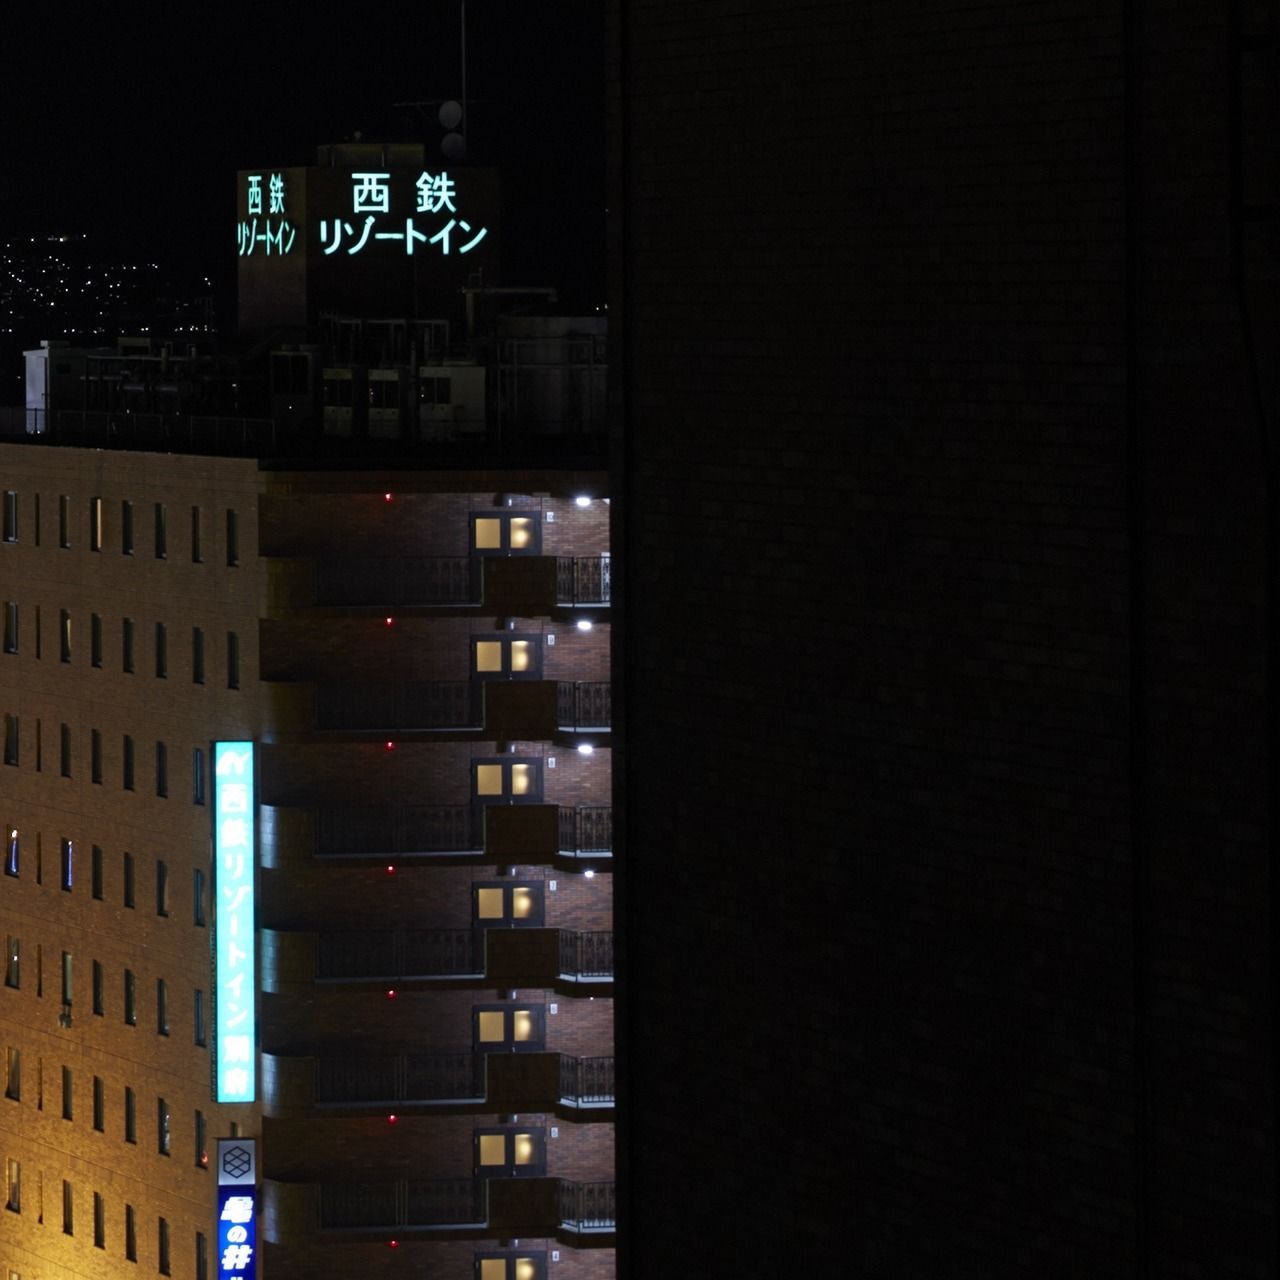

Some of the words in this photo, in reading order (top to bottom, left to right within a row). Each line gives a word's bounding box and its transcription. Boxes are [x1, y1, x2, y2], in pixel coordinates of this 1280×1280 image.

[247, 173, 286, 215] 西鉄
[351, 170, 457, 213] 西鉄
[237, 217, 296, 256] リゾートイン
[319, 215, 488, 256] リゾートイン
